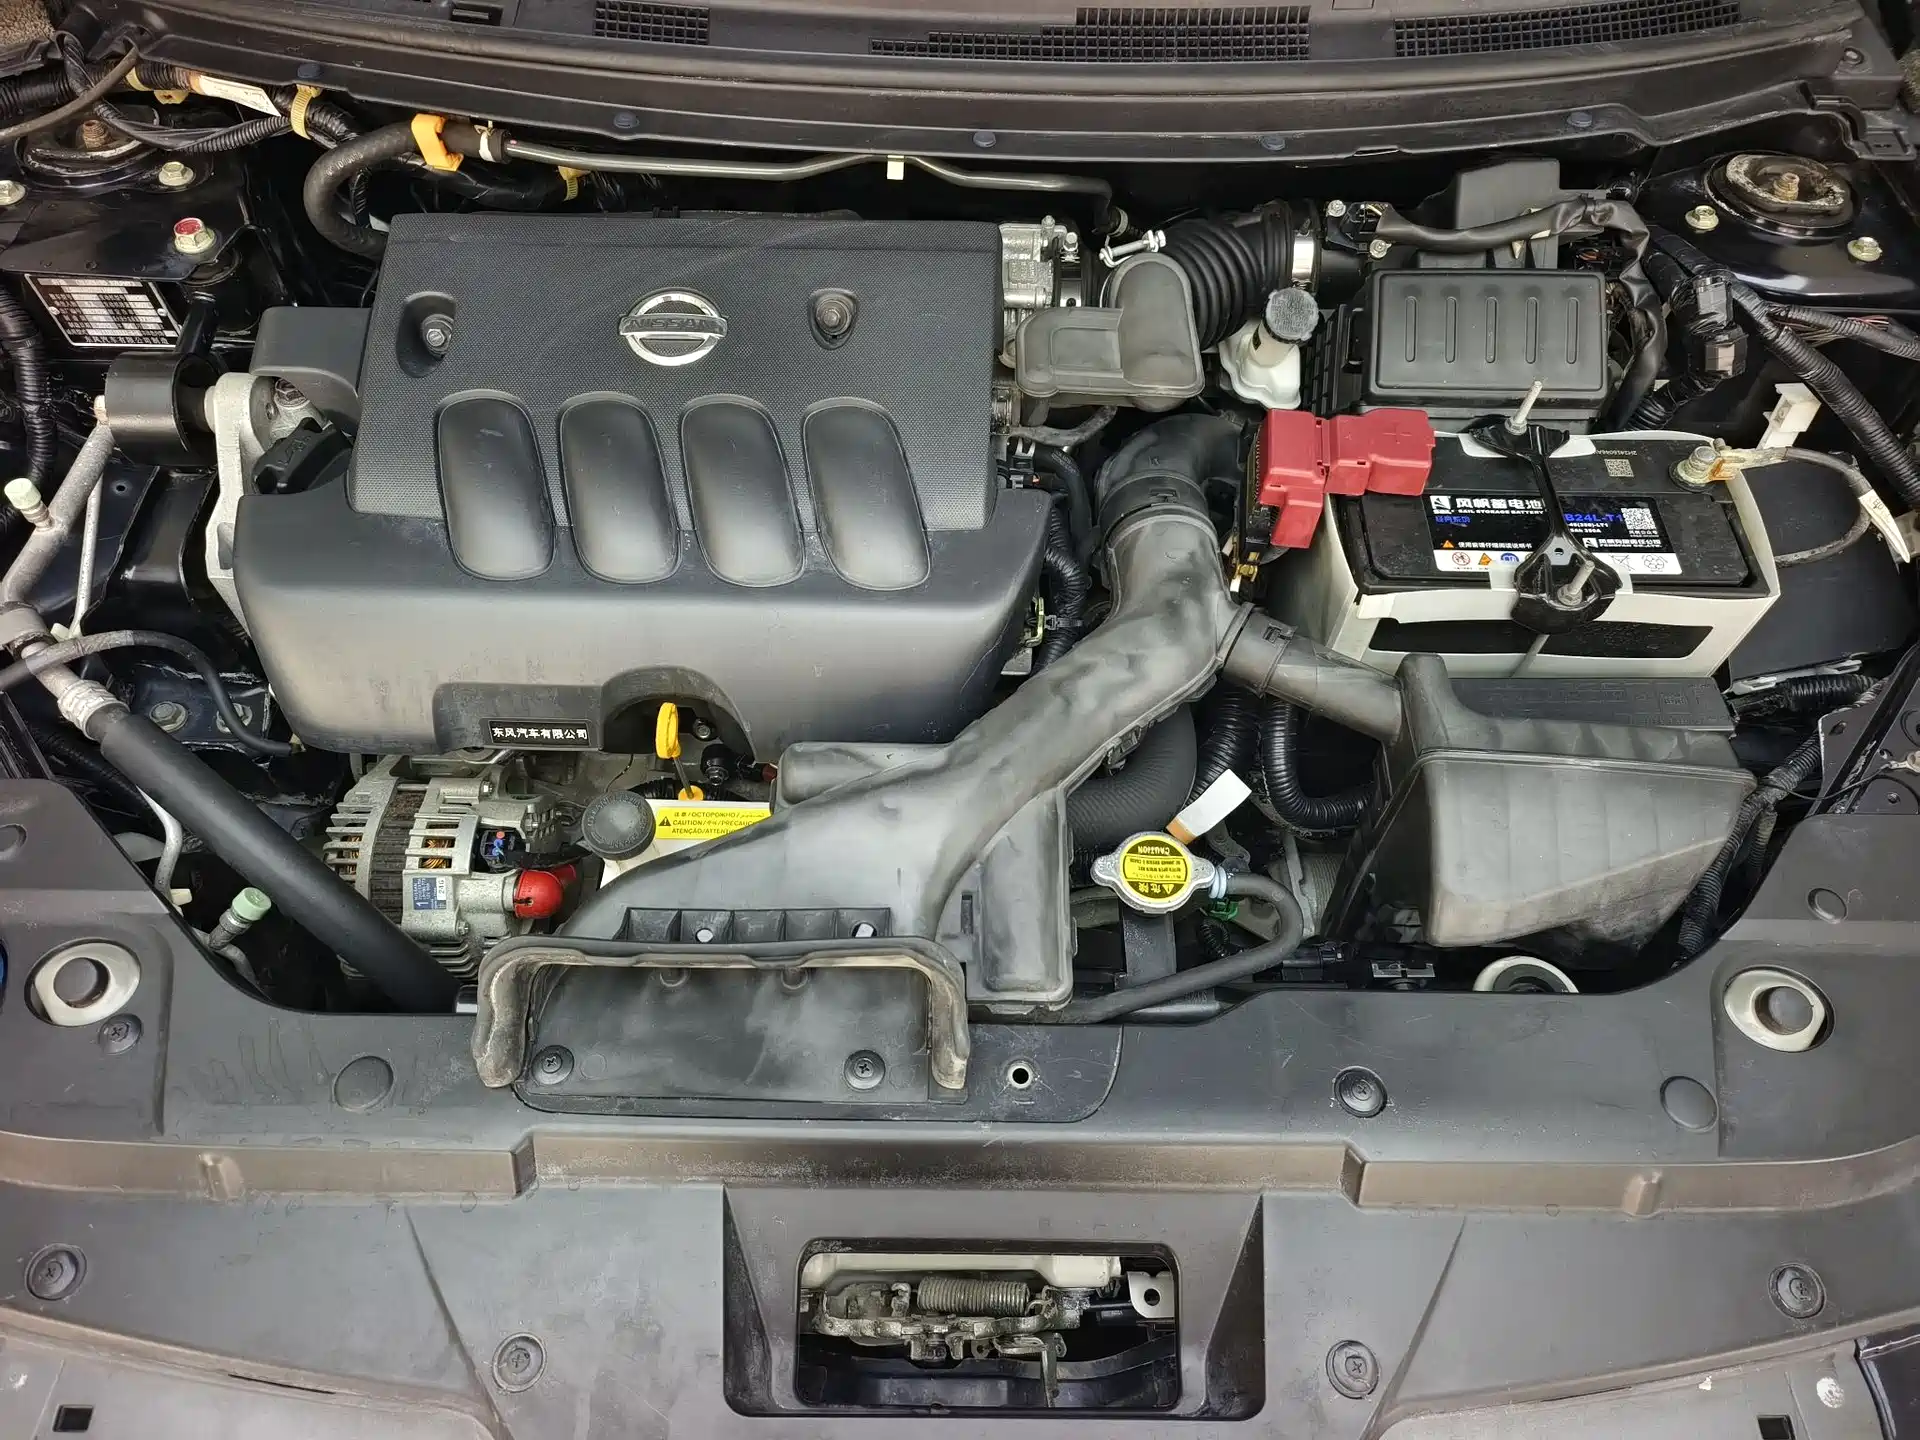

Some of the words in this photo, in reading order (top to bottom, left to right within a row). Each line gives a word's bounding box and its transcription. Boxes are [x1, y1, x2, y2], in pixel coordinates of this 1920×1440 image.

[625, 317, 716, 331] NISSAN
[1455, 497, 1543, 510] 风帆蓄电池
[1564, 513, 1623, 522] B24L-T1
[492, 727, 588, 740] 东风汽车有限公司
[1138, 846, 1170, 855] CAUTION
